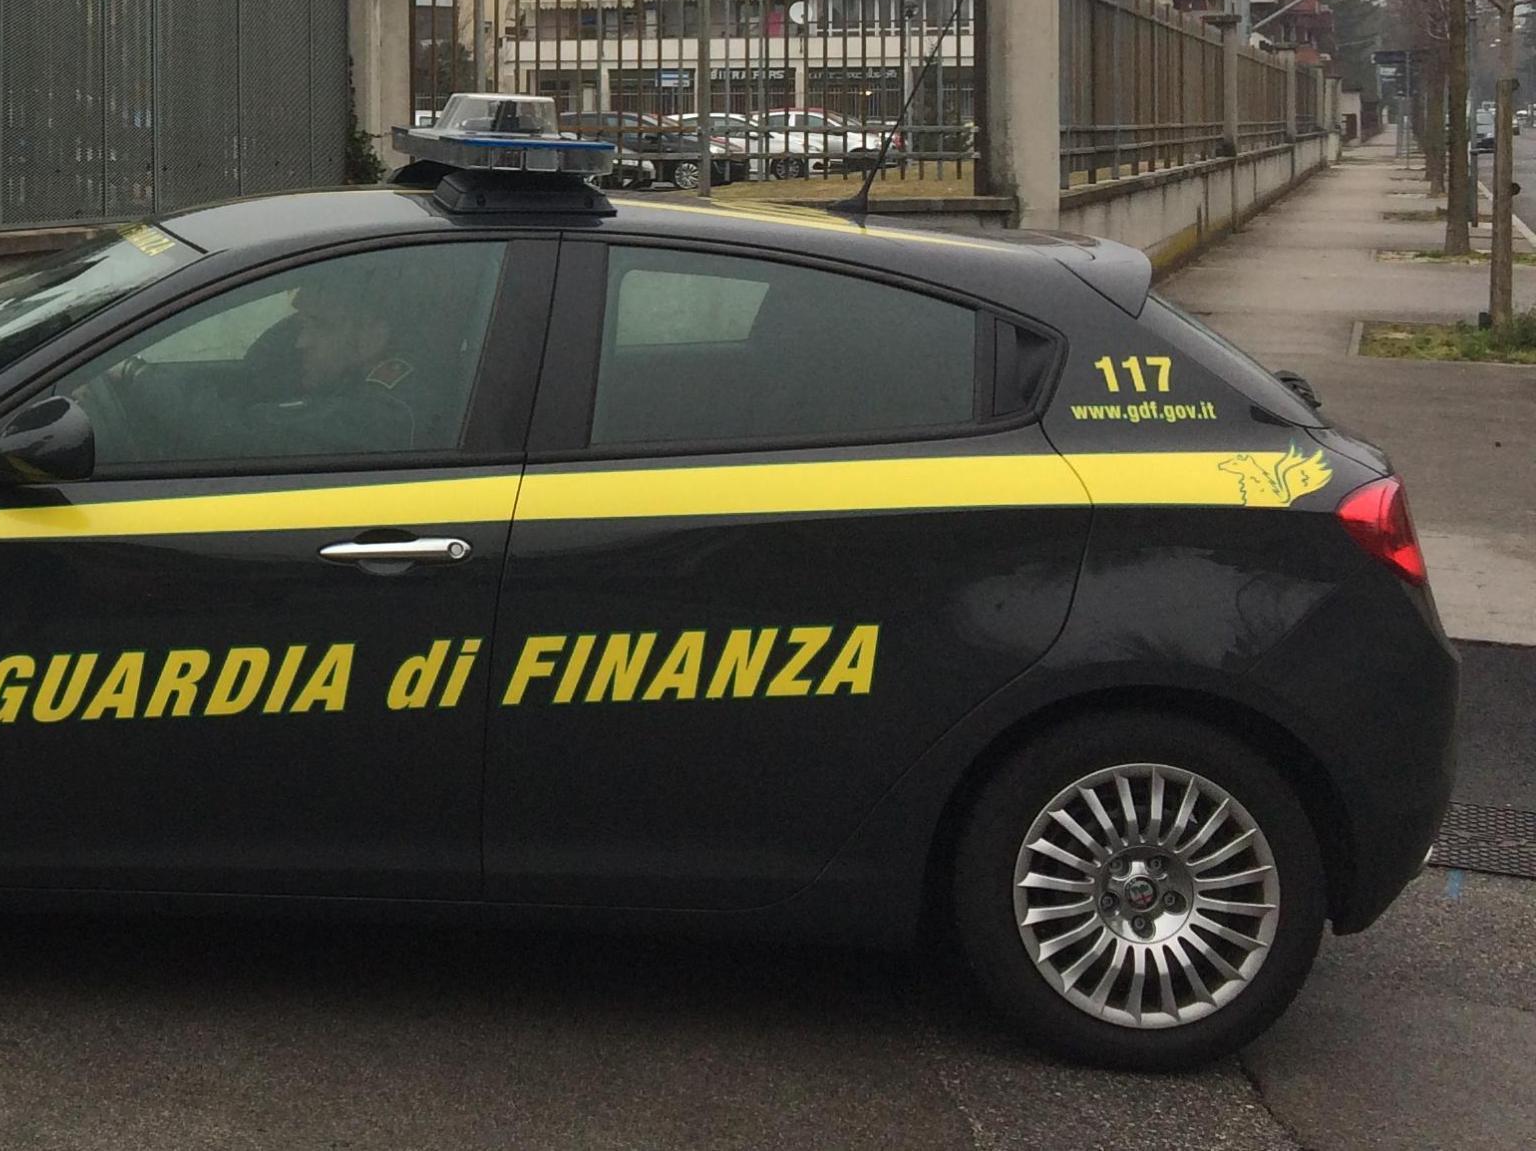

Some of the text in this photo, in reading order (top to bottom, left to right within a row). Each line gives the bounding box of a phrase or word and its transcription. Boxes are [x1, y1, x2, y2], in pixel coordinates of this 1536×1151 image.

[1094, 356, 1173, 393] 117
[1071, 401, 1217, 424] www.gdf.gov.it
[386, 638, 482, 711] di
[502, 624, 881, 705] FINANZA
